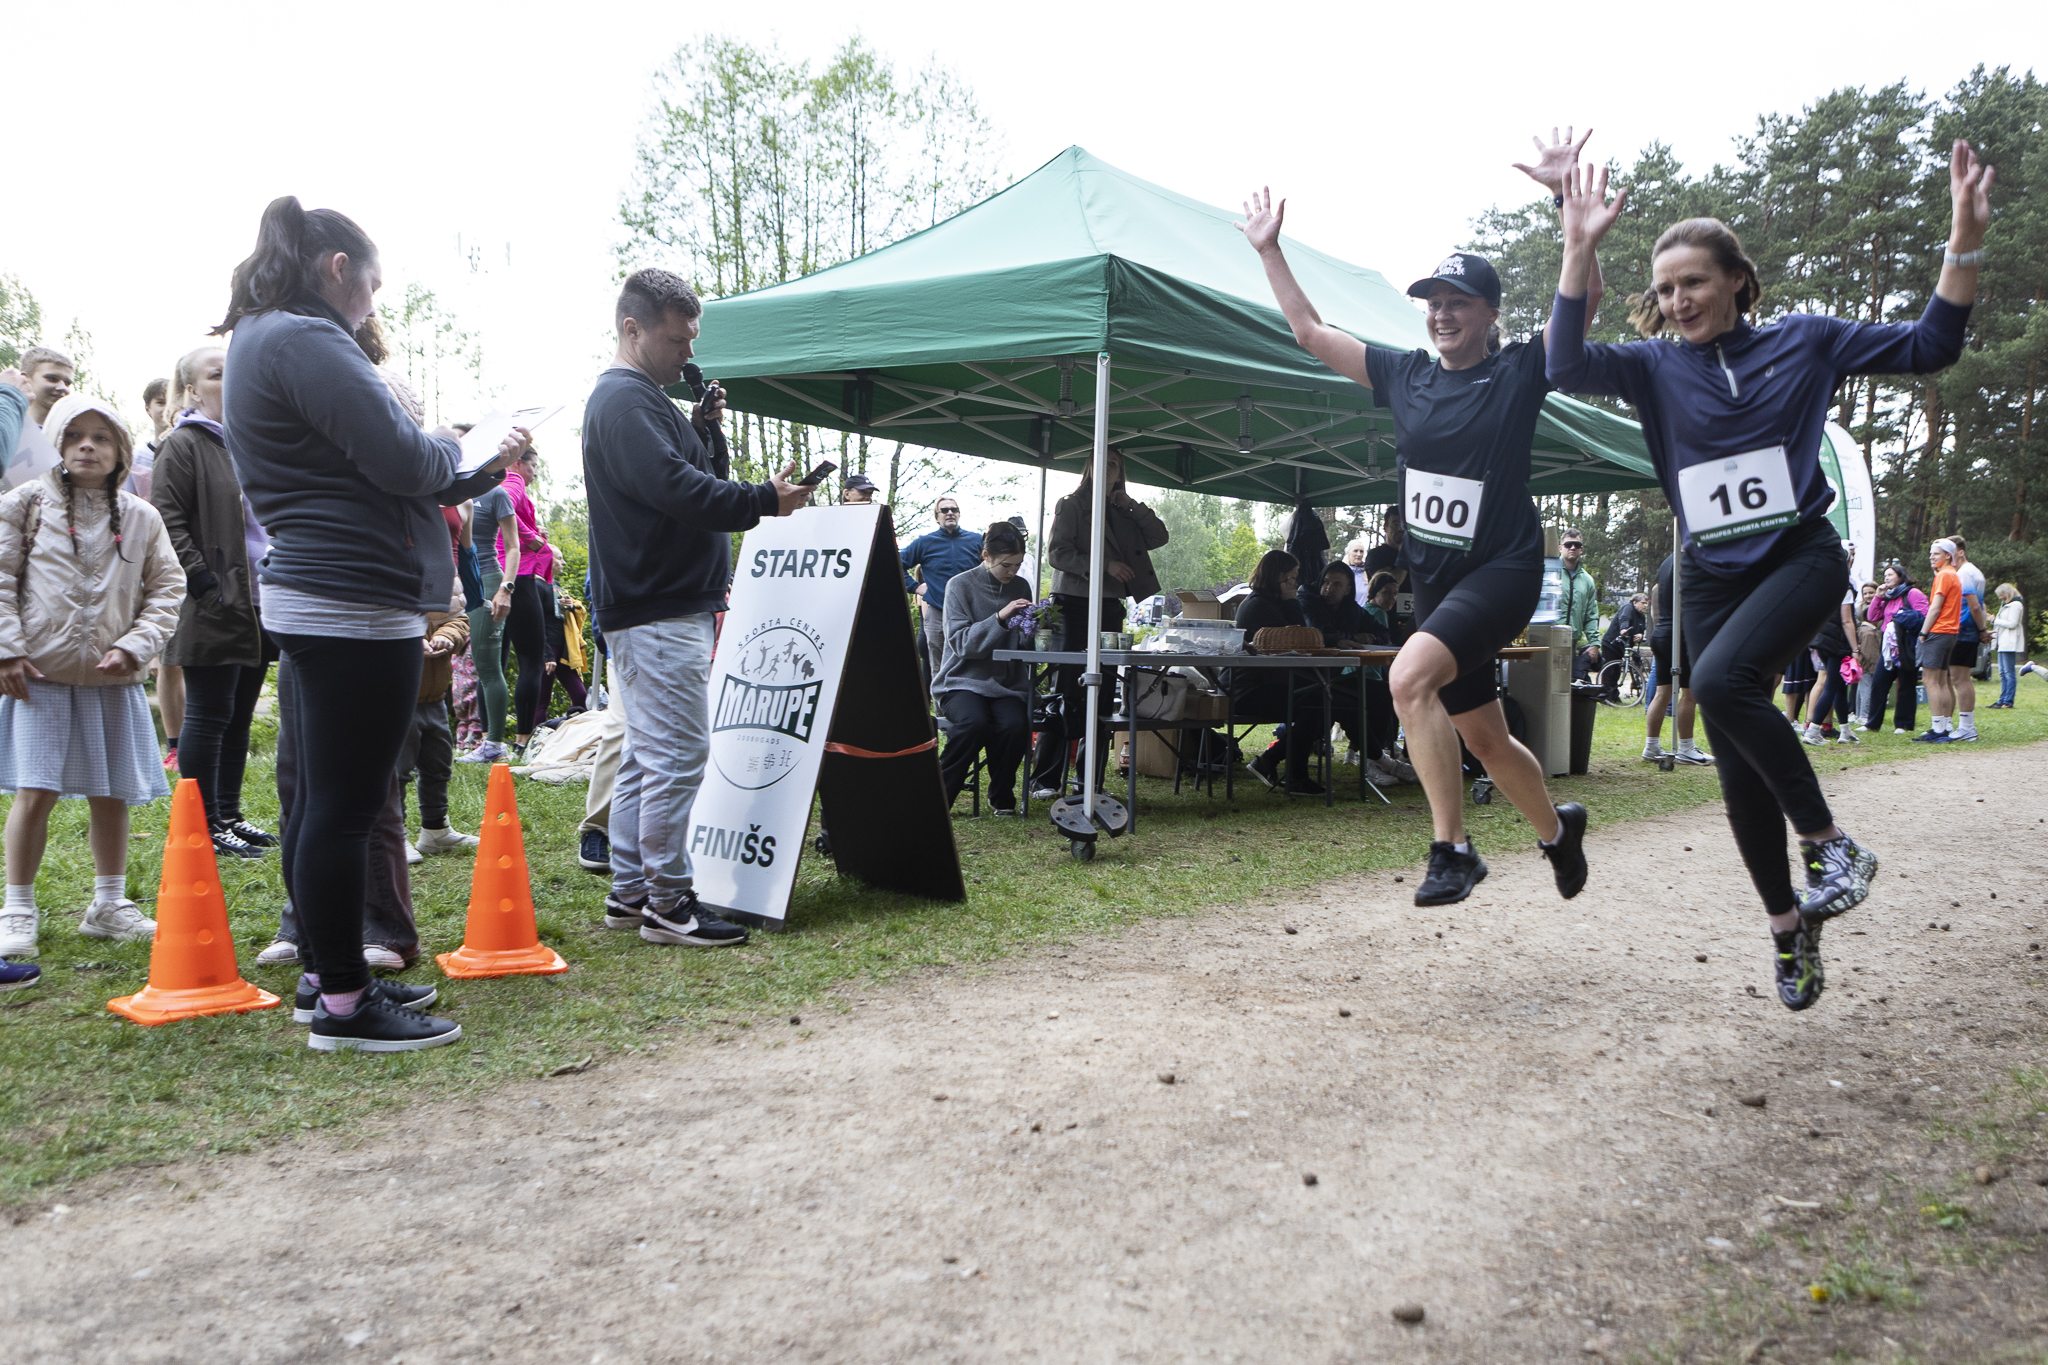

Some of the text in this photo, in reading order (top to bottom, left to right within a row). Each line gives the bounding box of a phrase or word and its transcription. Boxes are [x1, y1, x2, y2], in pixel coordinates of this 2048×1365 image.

[1411, 492, 1469, 529] 100
[1709, 476, 1767, 516] 16
[1732, 522, 1760, 532] SPORTA
[751, 548, 852, 579] STARTS
[738, 617, 825, 650] SPORTA CENTRS
[715, 678, 818, 738] MĀRUPE
[690, 823, 777, 868] FINIŠS
